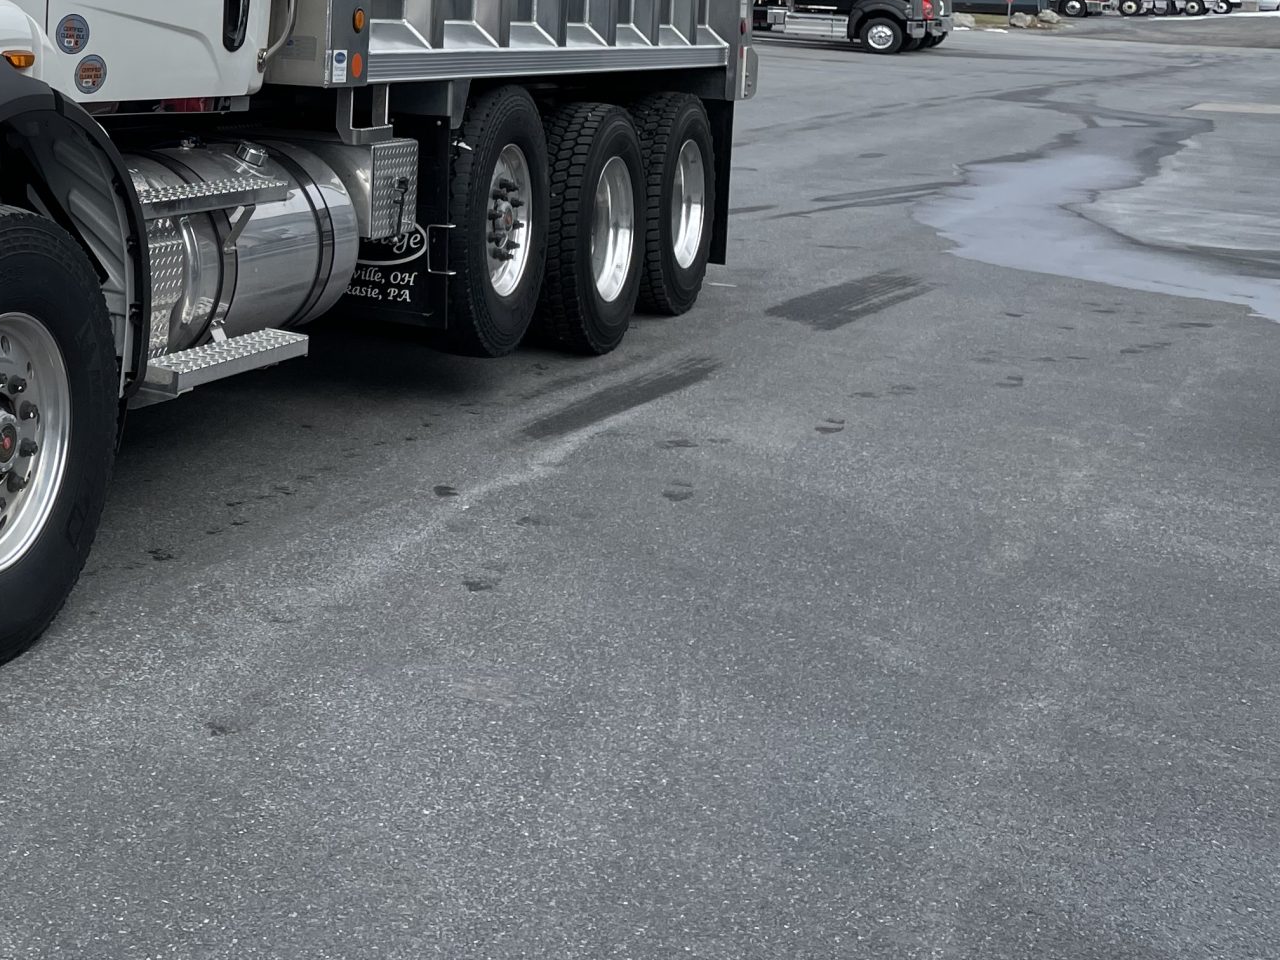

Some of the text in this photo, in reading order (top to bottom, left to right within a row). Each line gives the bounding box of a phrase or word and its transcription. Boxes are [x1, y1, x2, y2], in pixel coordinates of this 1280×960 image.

[353, 267, 418, 286] ville, OH
[387, 288, 412, 302] PA
